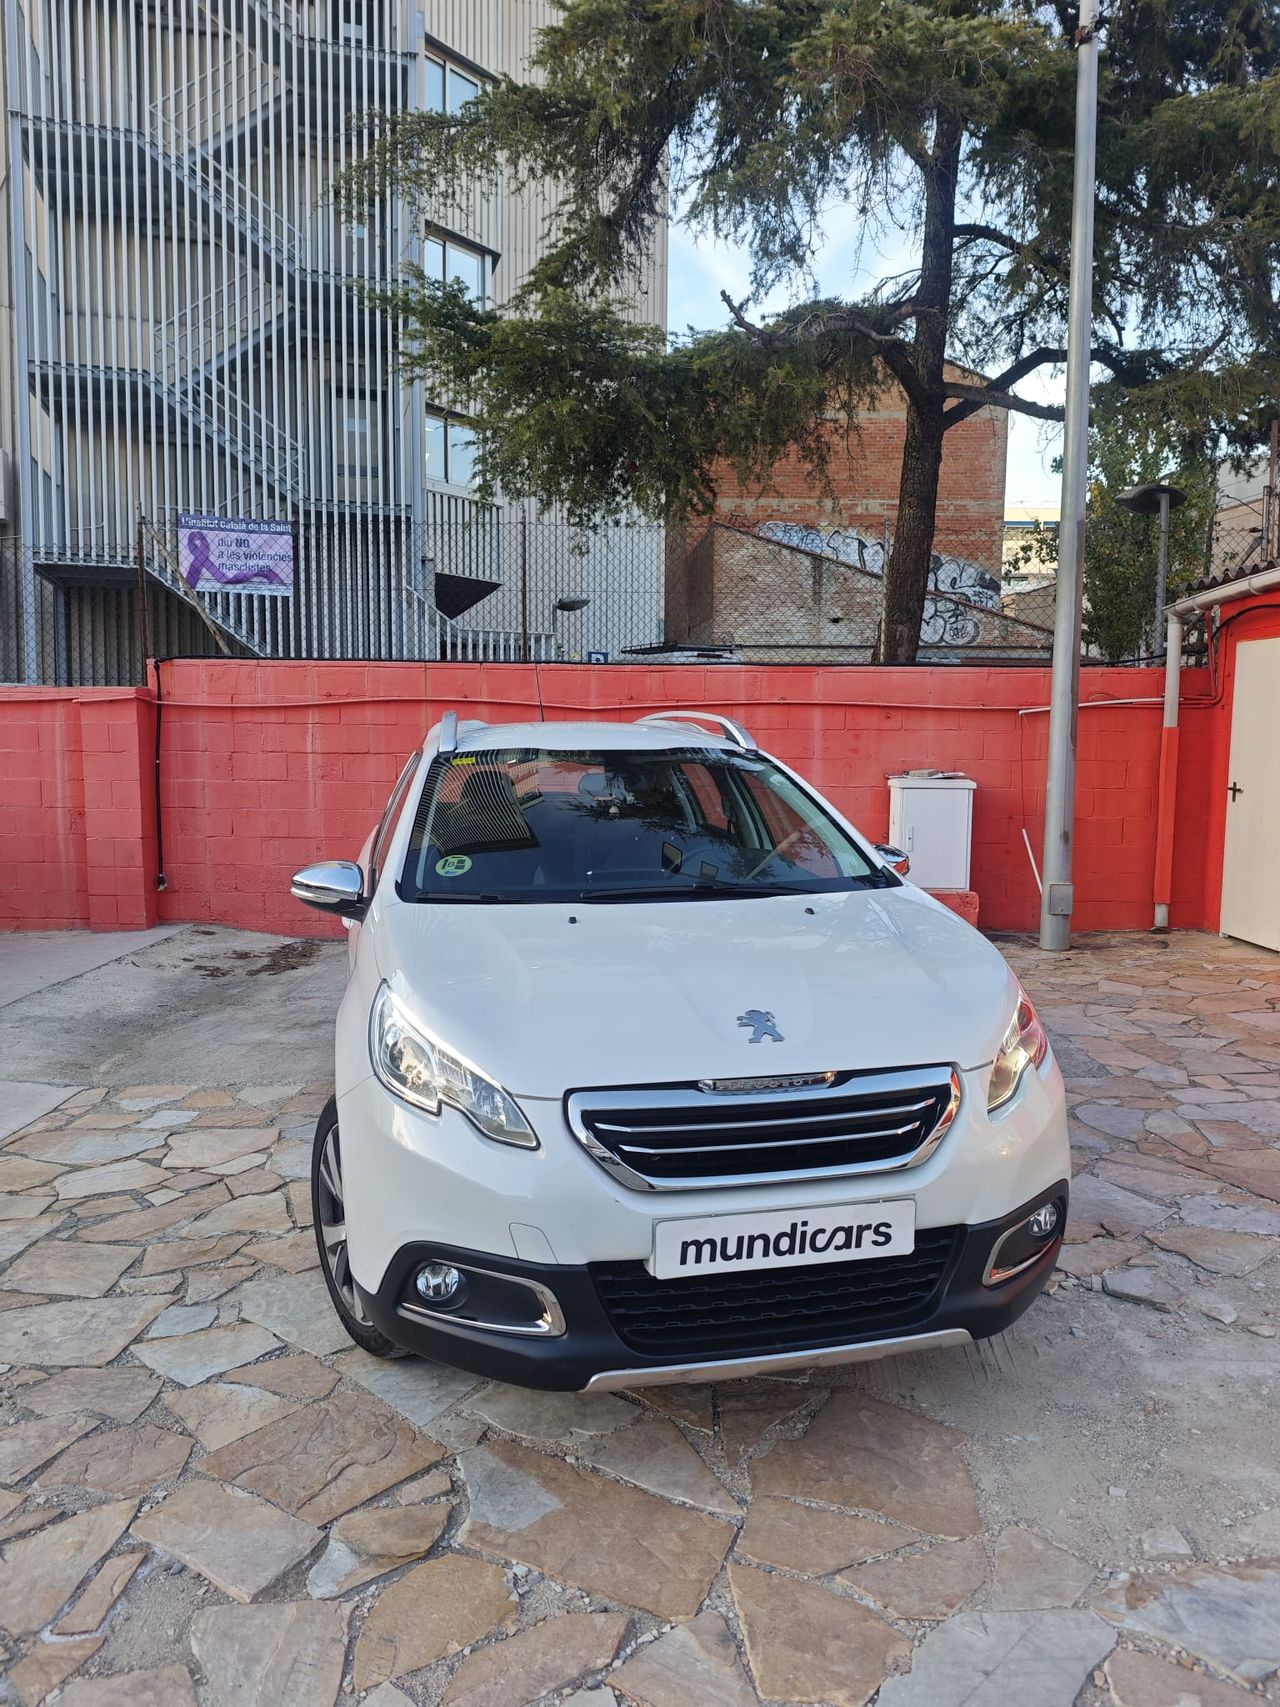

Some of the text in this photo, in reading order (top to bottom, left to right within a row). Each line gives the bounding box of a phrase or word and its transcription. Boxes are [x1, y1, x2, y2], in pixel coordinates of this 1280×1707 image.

[219, 520, 246, 530] Català
[249, 523, 259, 531] de
[260, 523, 269, 531] la
[270, 523, 292, 533] Salut
[218, 538, 250, 548] diu NO
[218, 551, 224, 559] a
[227, 550, 241, 560] les
[218, 563, 271, 572] masclistes
[679, 1220, 893, 1266] mundicars
